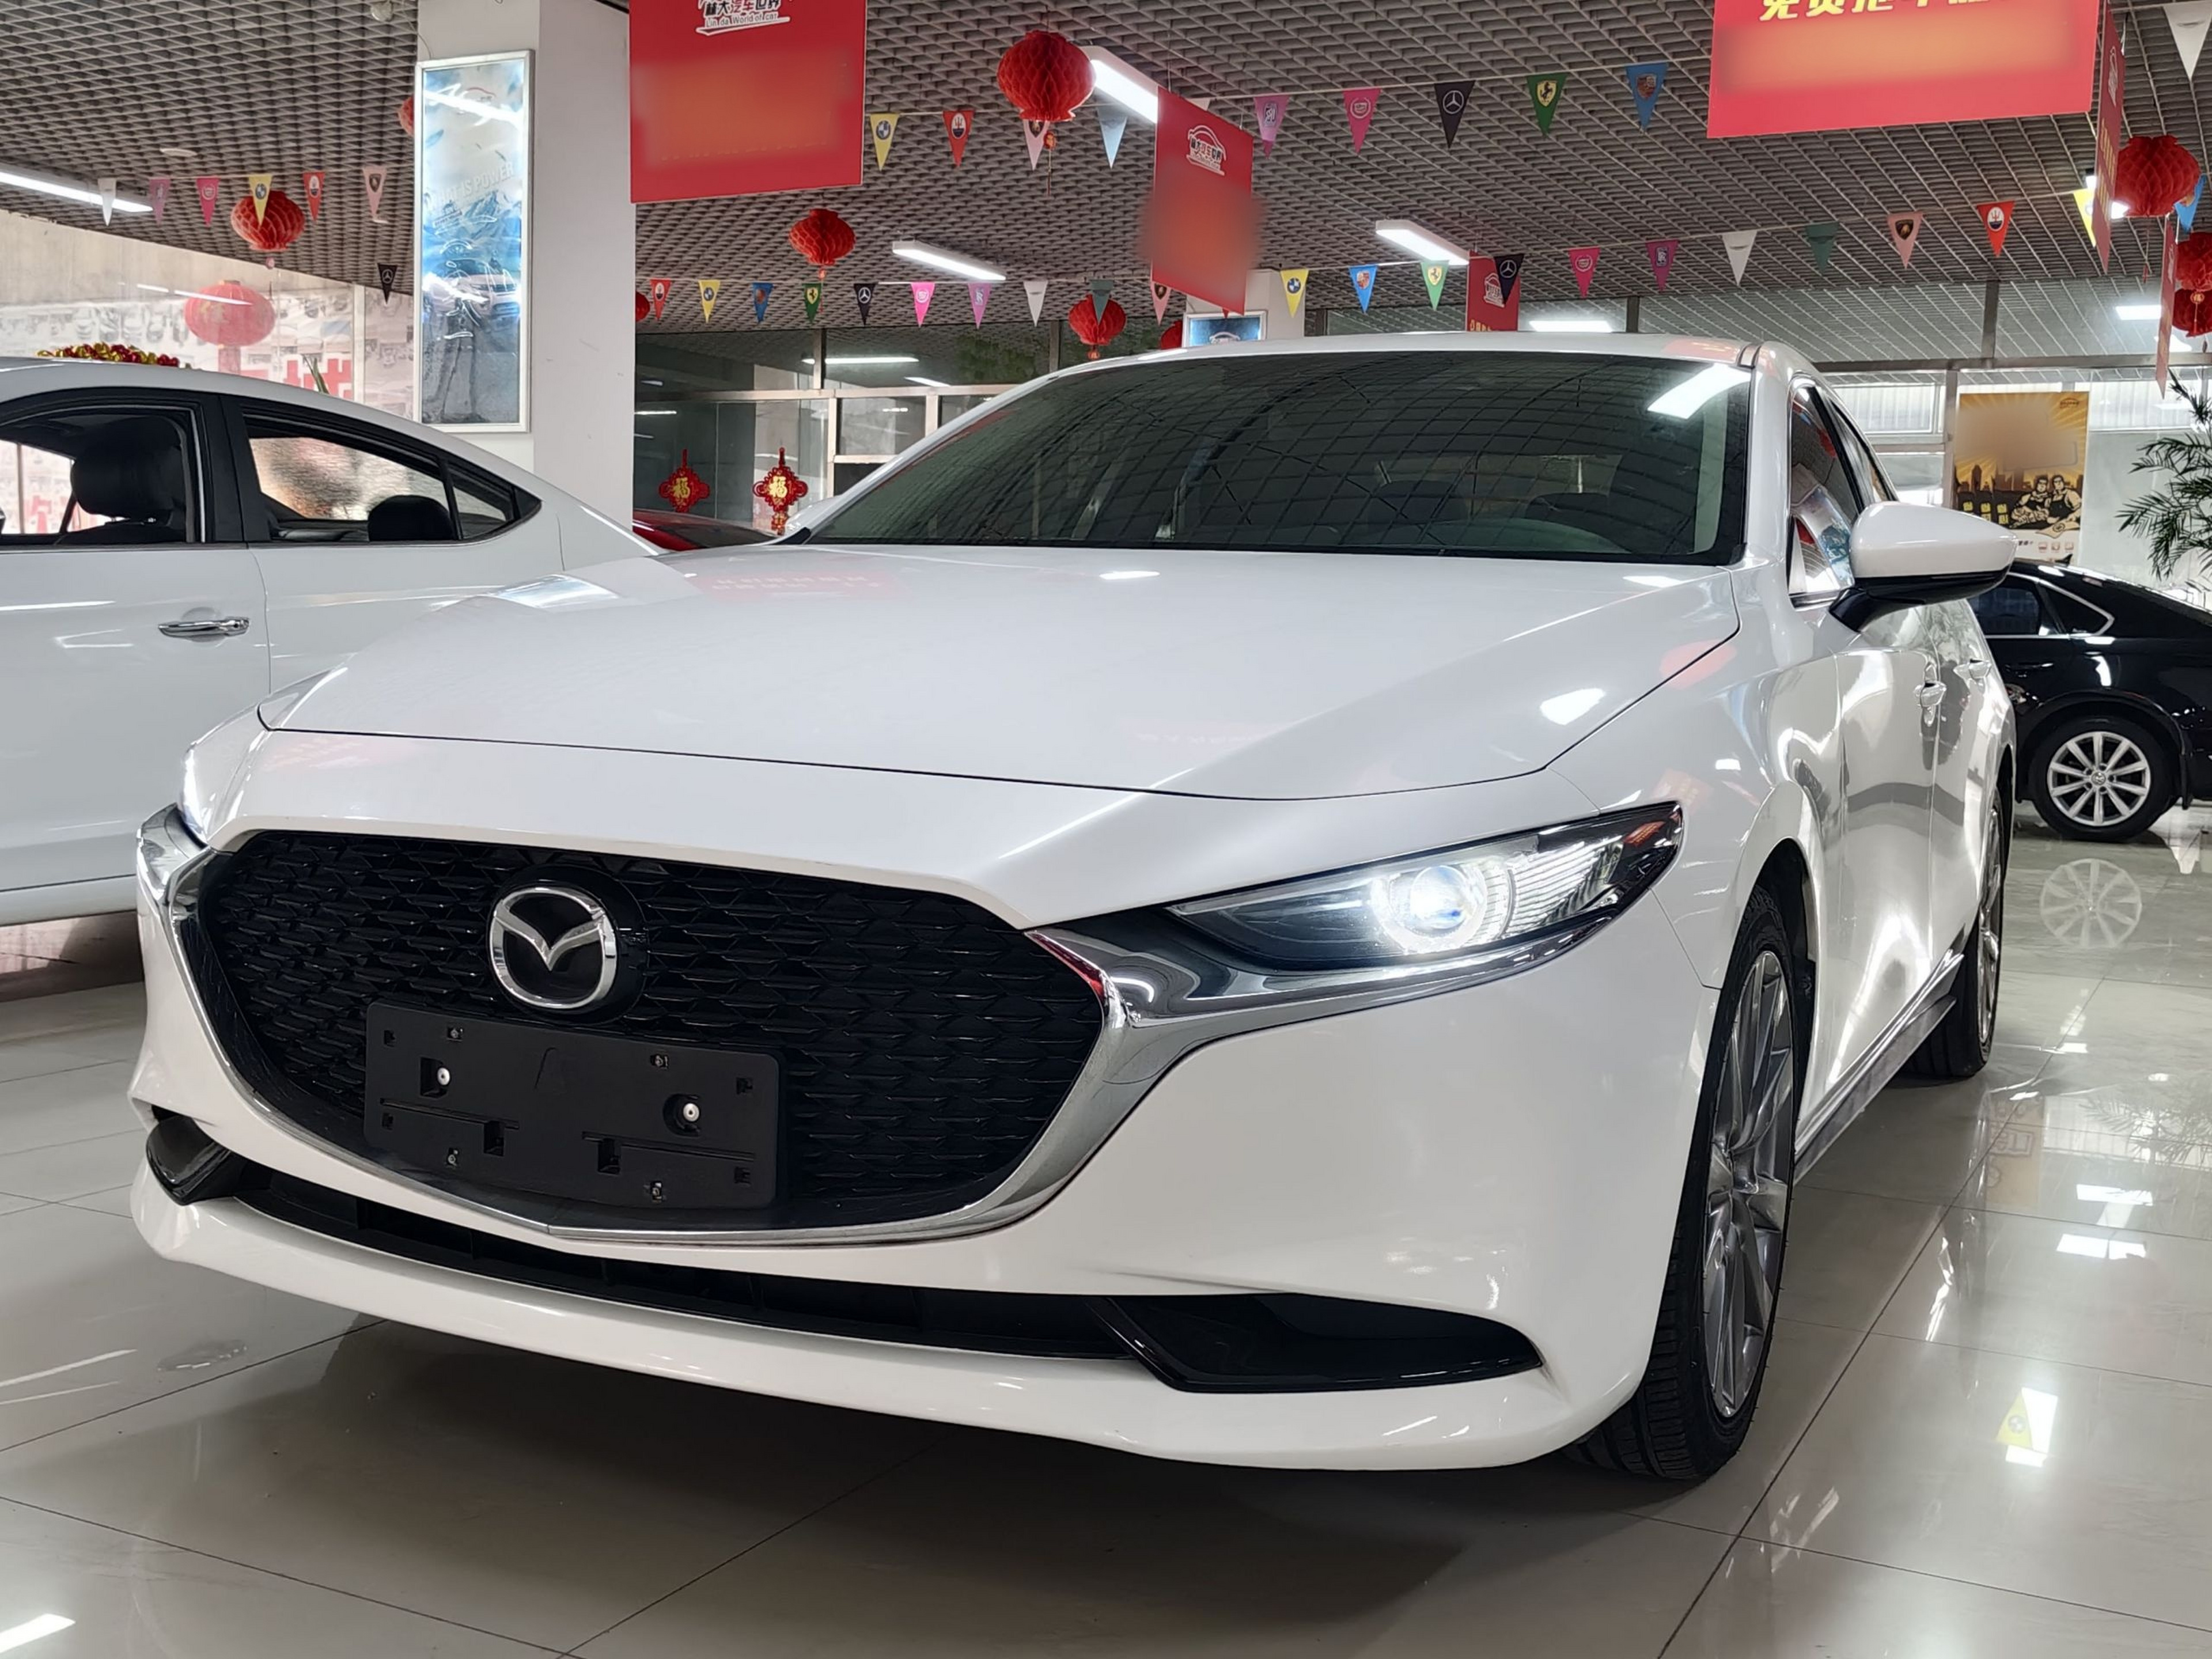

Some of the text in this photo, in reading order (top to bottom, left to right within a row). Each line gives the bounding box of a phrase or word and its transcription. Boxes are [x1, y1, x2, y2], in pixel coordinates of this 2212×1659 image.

[706, 18, 717, 27] Lin
[721, 17, 729, 25] da
[733, 14, 753, 24] World
[755, 13, 762, 22] of
[474, 161, 513, 195] POWER
[768, 476, 787, 498] 福
